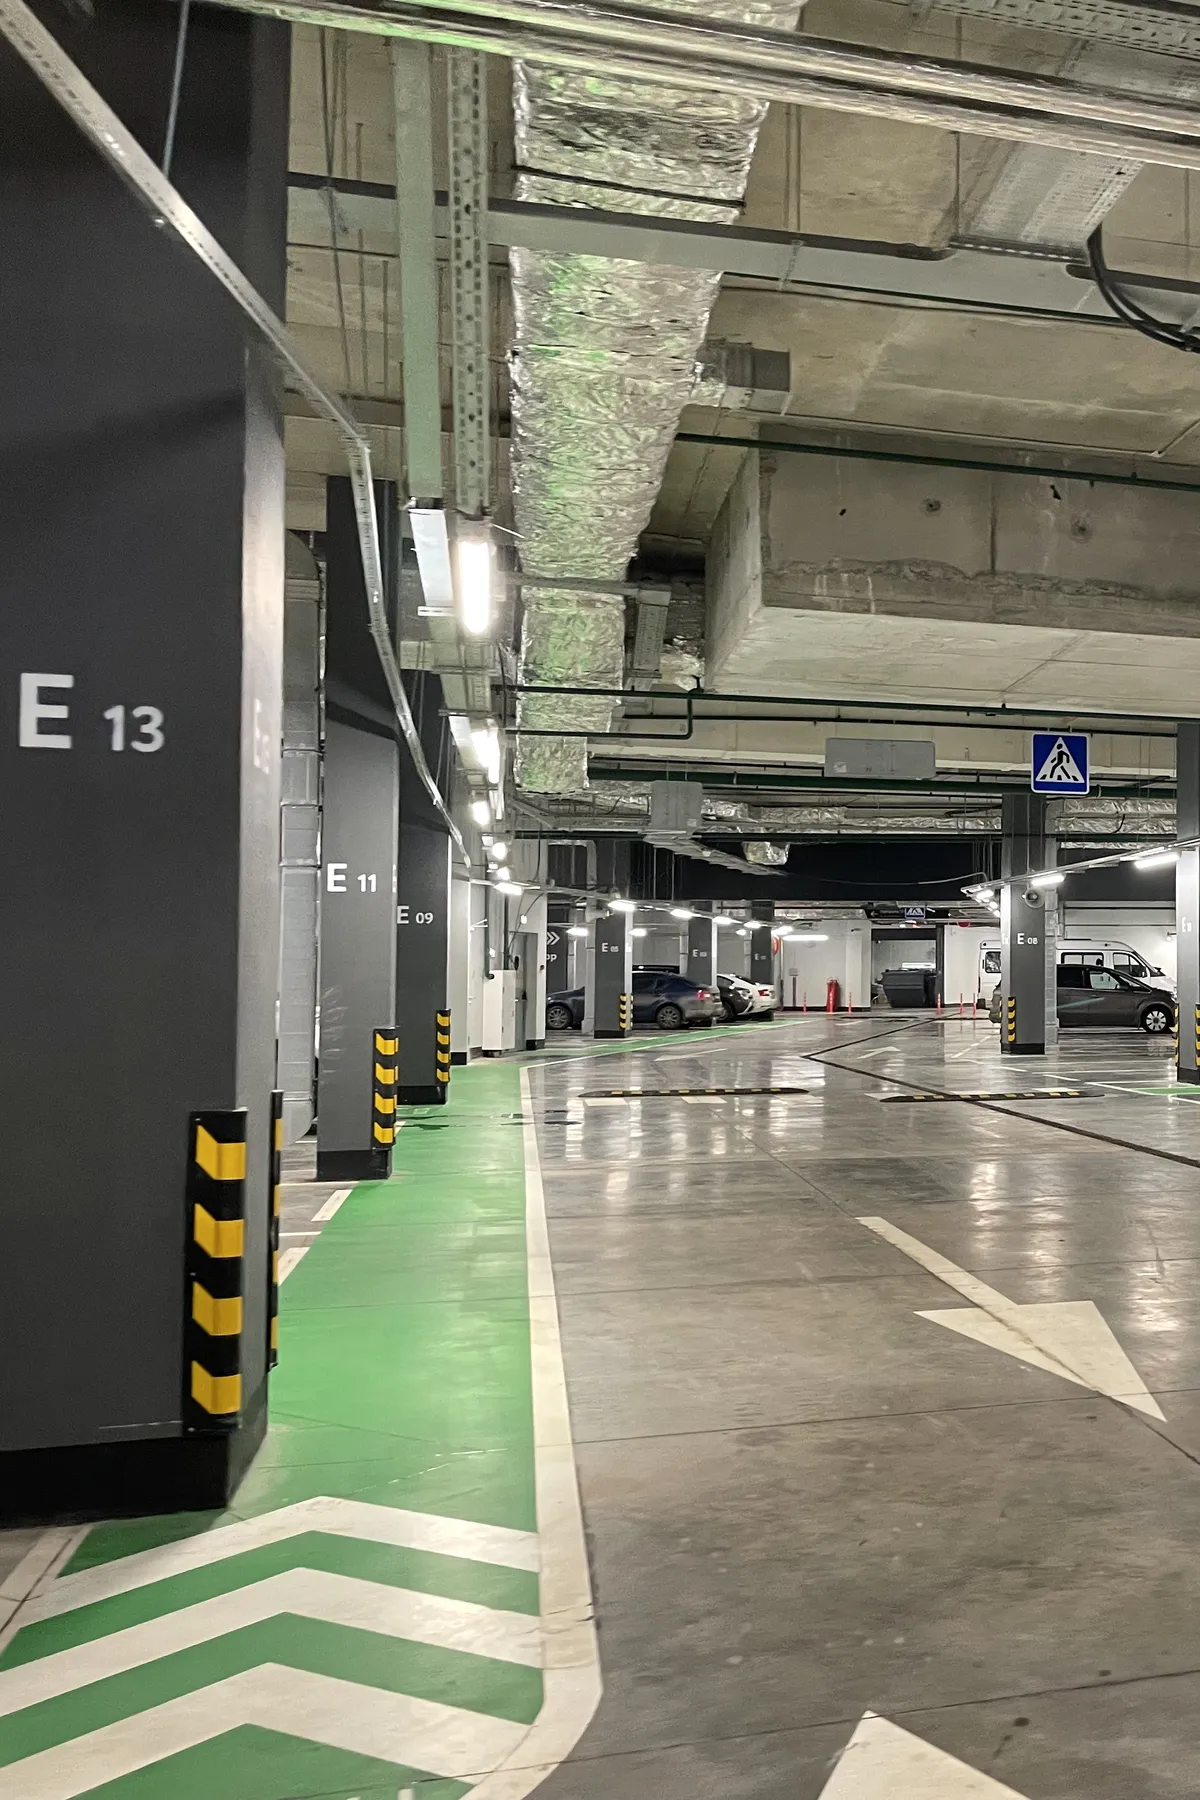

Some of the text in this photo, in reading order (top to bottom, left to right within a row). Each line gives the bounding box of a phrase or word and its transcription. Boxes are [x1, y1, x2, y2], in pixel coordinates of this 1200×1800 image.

[19, 672, 165, 753] E 13
[326, 863, 348, 892] E
[357, 873, 377, 893] 11
[397, 905, 434, 924] E 09
[601, 942, 609, 953] E
[1017, 932, 1025, 945] E
[1027, 937, 1038, 945] 08
